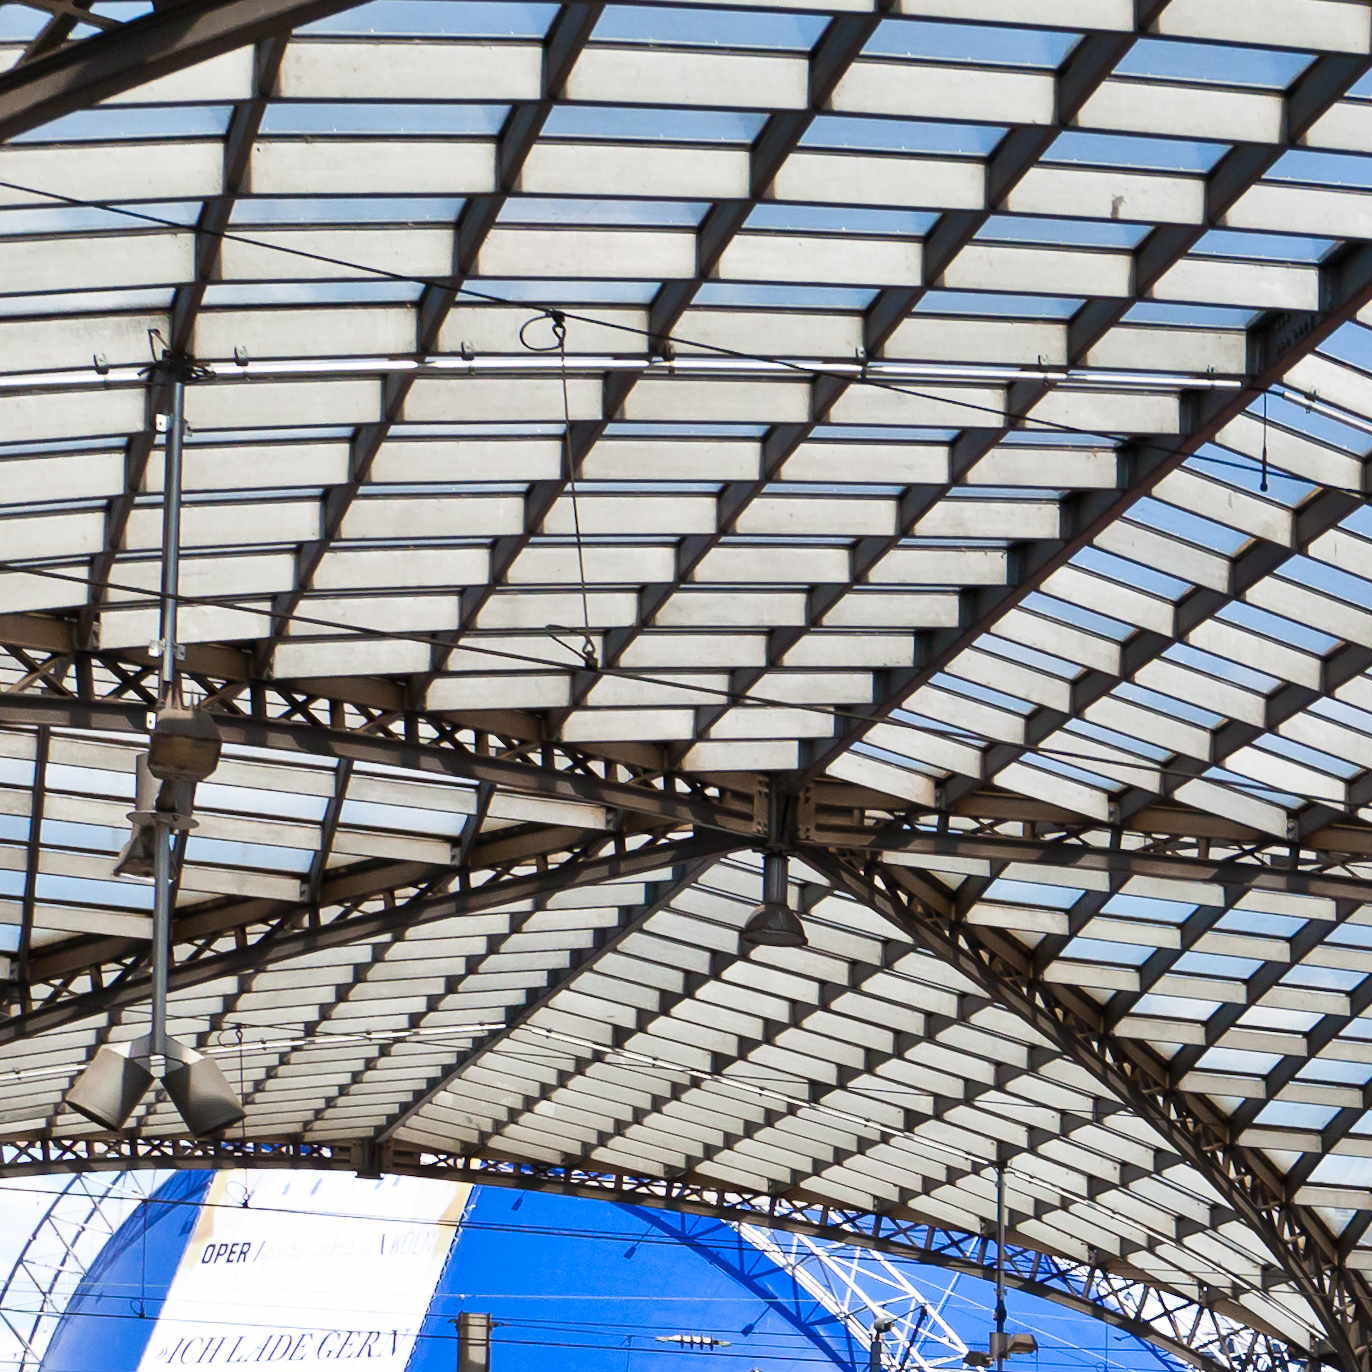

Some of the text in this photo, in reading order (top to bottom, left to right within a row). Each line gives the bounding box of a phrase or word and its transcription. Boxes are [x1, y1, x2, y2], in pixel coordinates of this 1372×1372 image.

[201, 1242, 251, 1264] OPER
[226, 1332, 314, 1363] LADE
[316, 1328, 410, 1361] GERN
